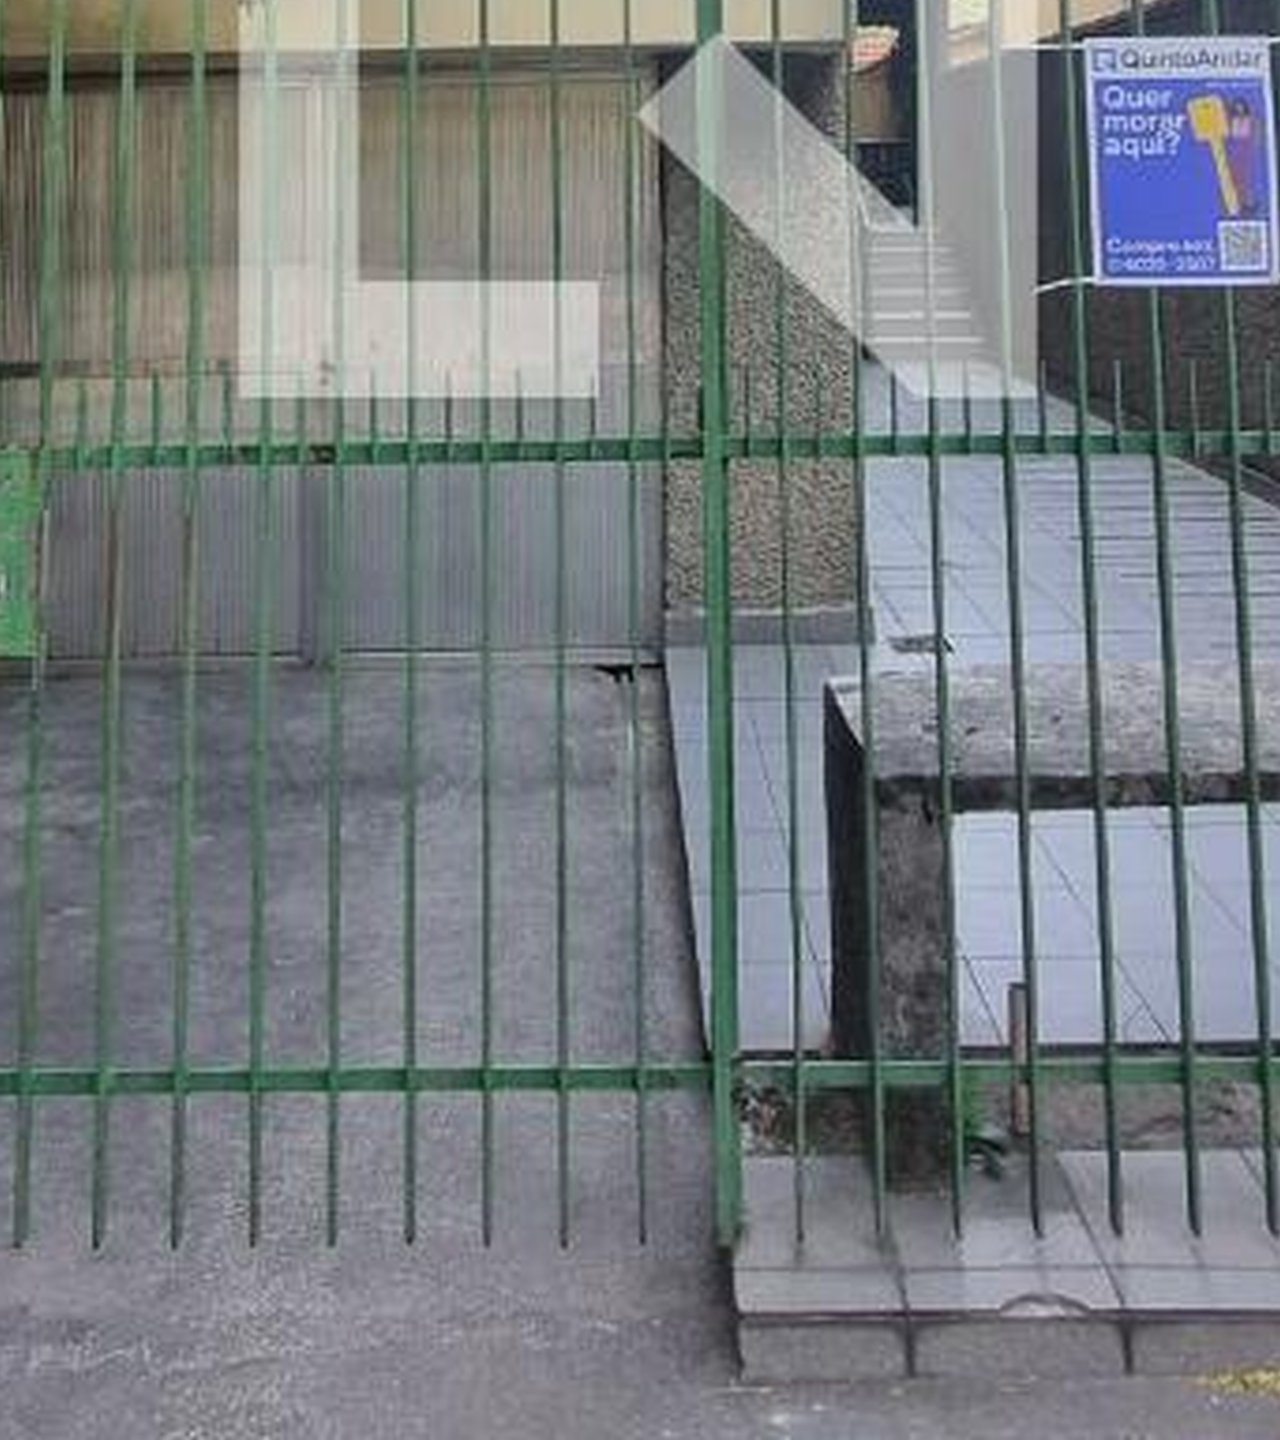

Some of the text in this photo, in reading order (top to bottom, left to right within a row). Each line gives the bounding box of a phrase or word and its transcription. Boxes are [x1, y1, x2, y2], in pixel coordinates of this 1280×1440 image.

[1120, 47, 1263, 69] QuintoAndar
[1103, 84, 1172, 109] Quer
[1103, 113, 1186, 132] morar
[1103, 130, 1182, 160] aqui?
